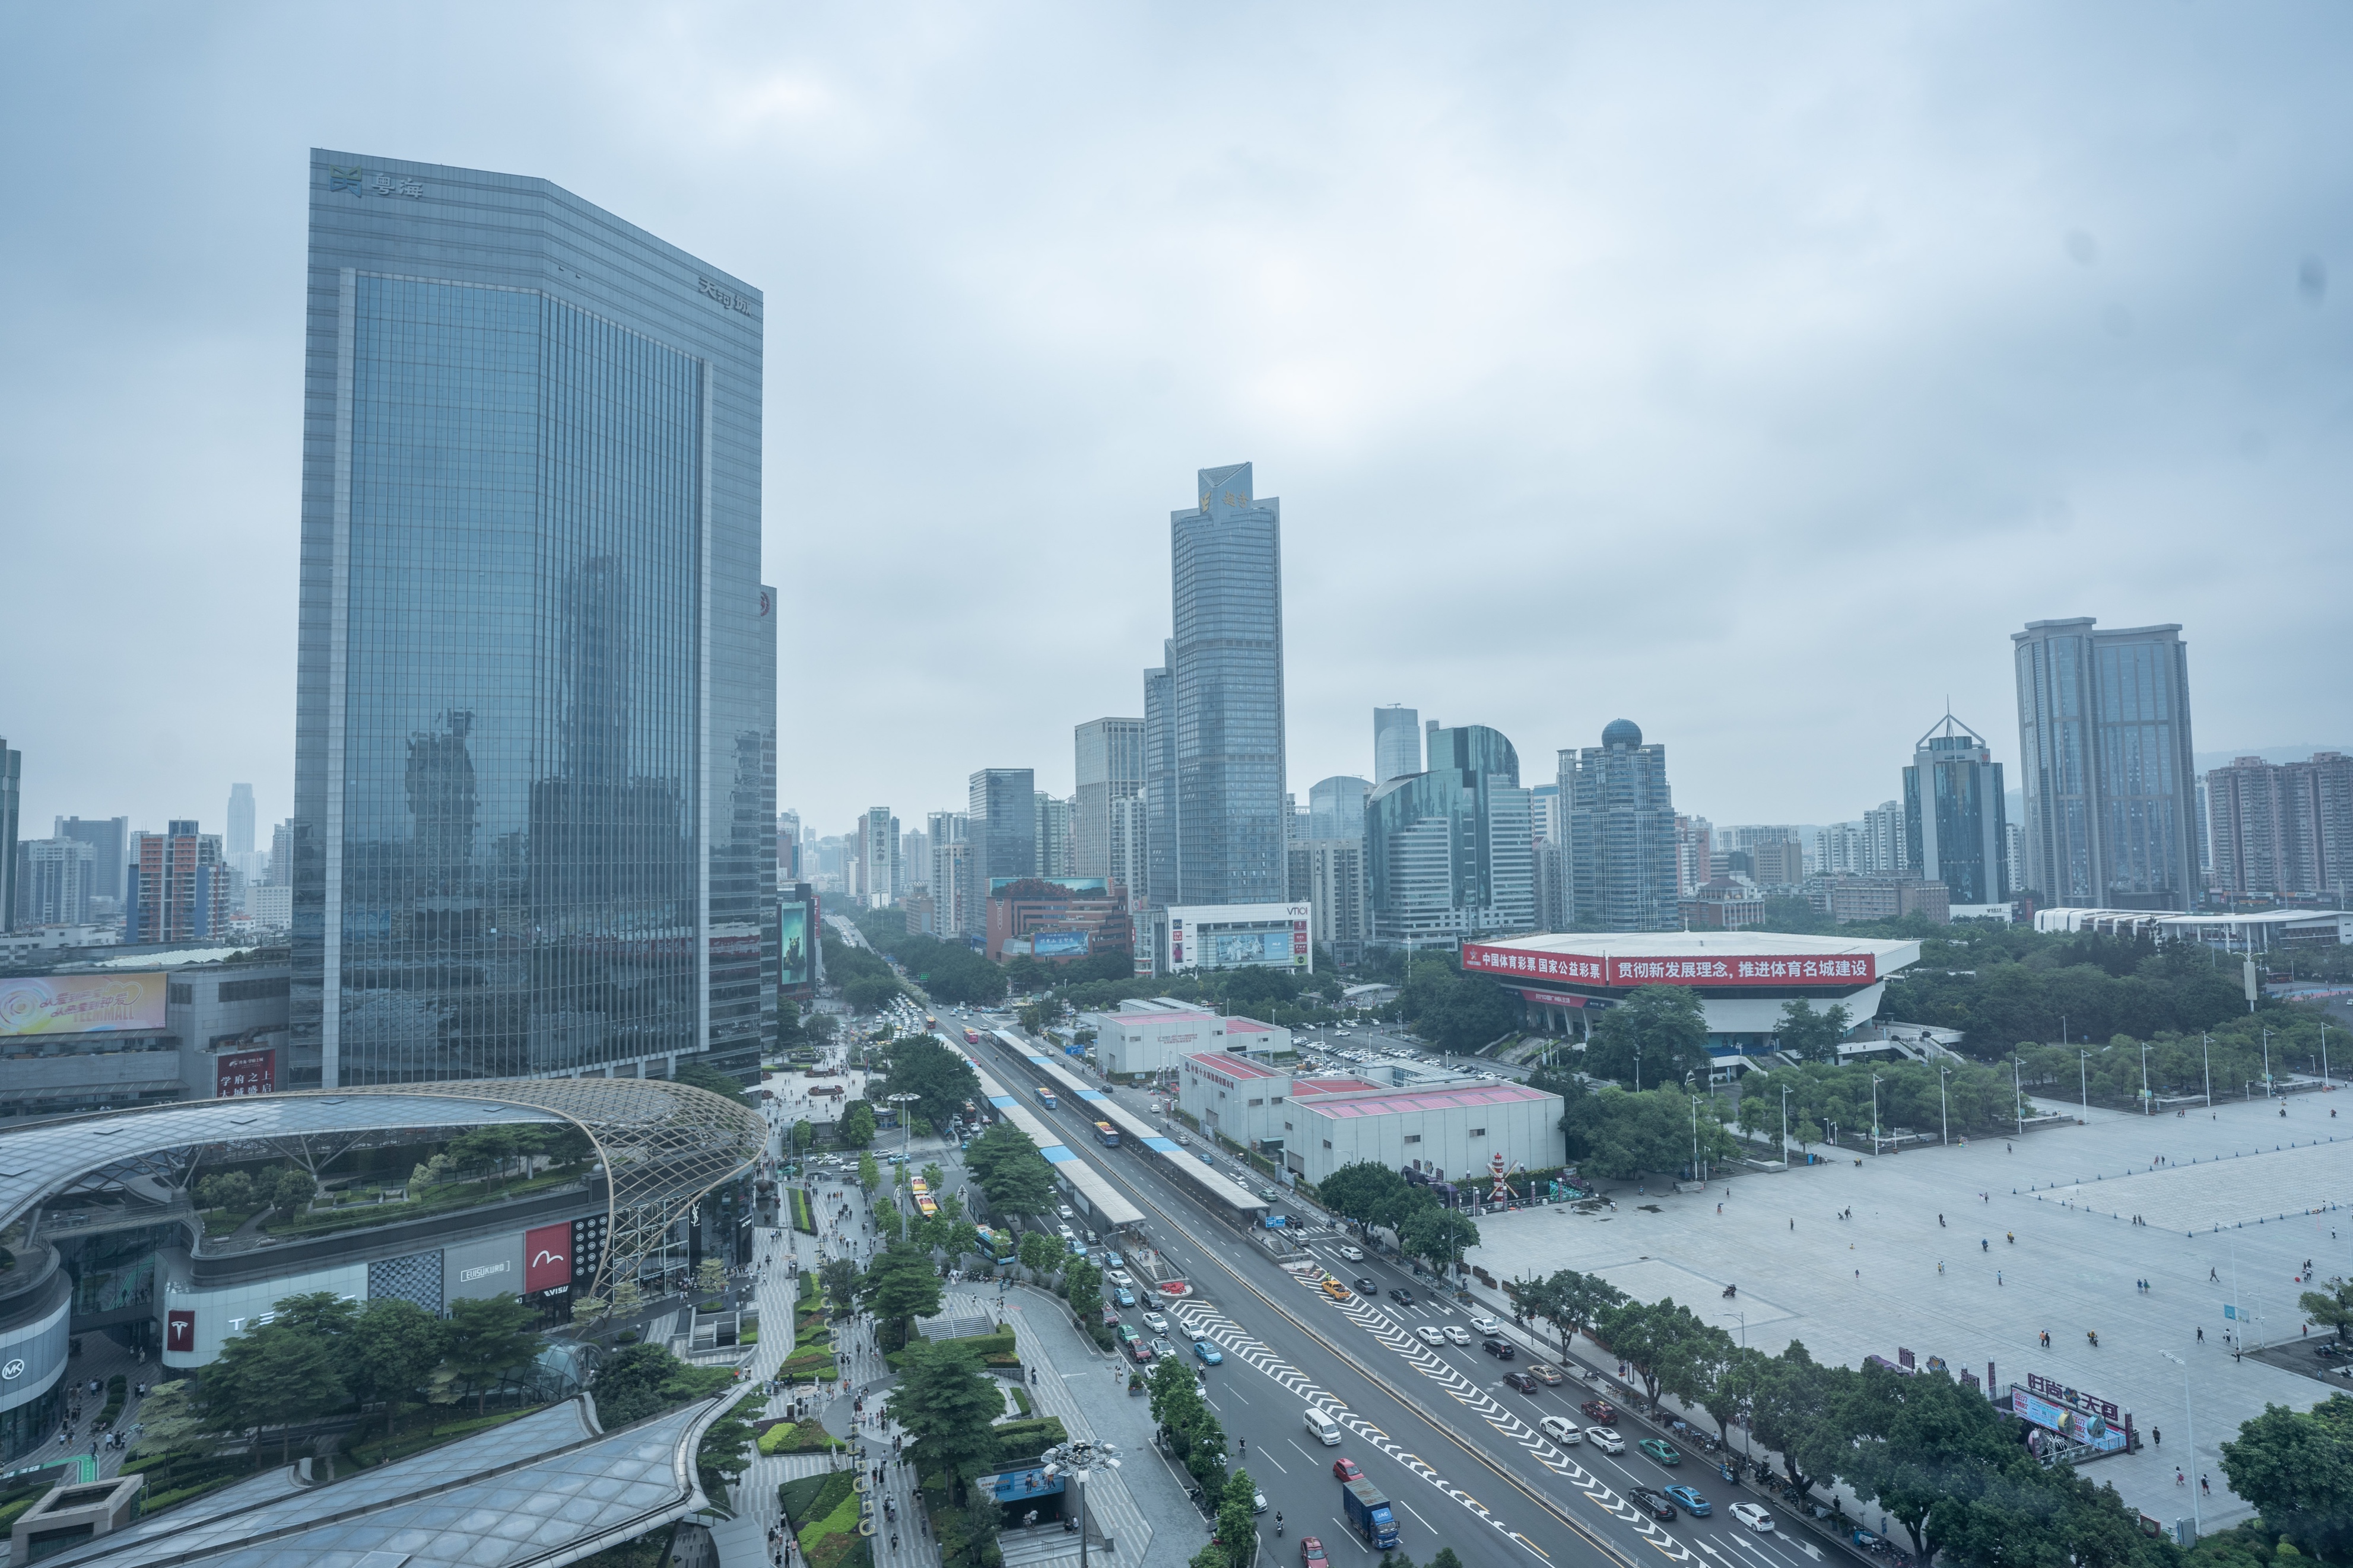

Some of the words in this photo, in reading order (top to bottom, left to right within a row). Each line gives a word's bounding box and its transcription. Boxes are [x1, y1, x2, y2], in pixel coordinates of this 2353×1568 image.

[371, 173, 423, 199] 粤海
[698, 276, 752, 316] 天河城
[1222, 489, 1250, 508] 越秀
[876, 830, 885, 861] 中国人寿
[1482, 952, 1536, 972] 中国体育彩票
[1538, 958, 1601, 979] 国家公益彩票
[1618, 960, 1868, 979] 贯彻新发展理念，推进体育名城建设
[220, 1070, 272, 1086] 学府之上
[544, 1285, 569, 1297] EVISU
[5, 1362, 22, 1376] MK
[2027, 1372, 2063, 1400] 时尚
